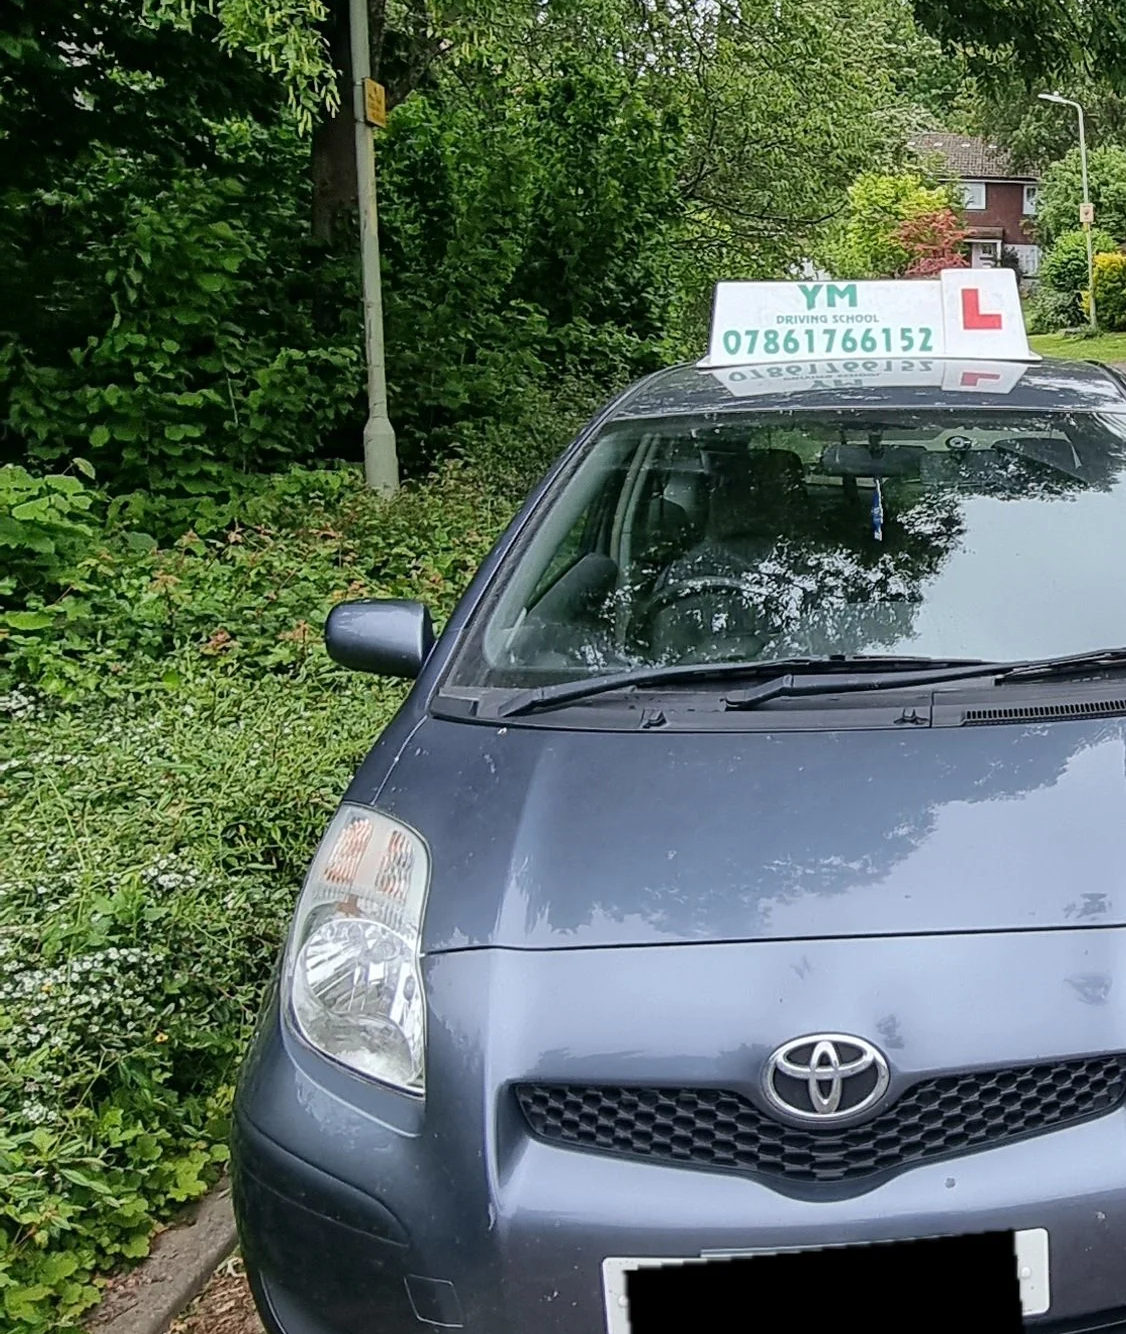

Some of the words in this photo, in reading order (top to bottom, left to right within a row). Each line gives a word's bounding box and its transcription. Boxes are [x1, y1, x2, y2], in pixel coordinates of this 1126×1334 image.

[798, 284, 858, 310] YM
[961, 288, 1002, 330] L
[776, 314, 829, 325] DRIVING
[832, 313, 879, 324] SCHOOL
[723, 328, 933, 356] 07861766152
